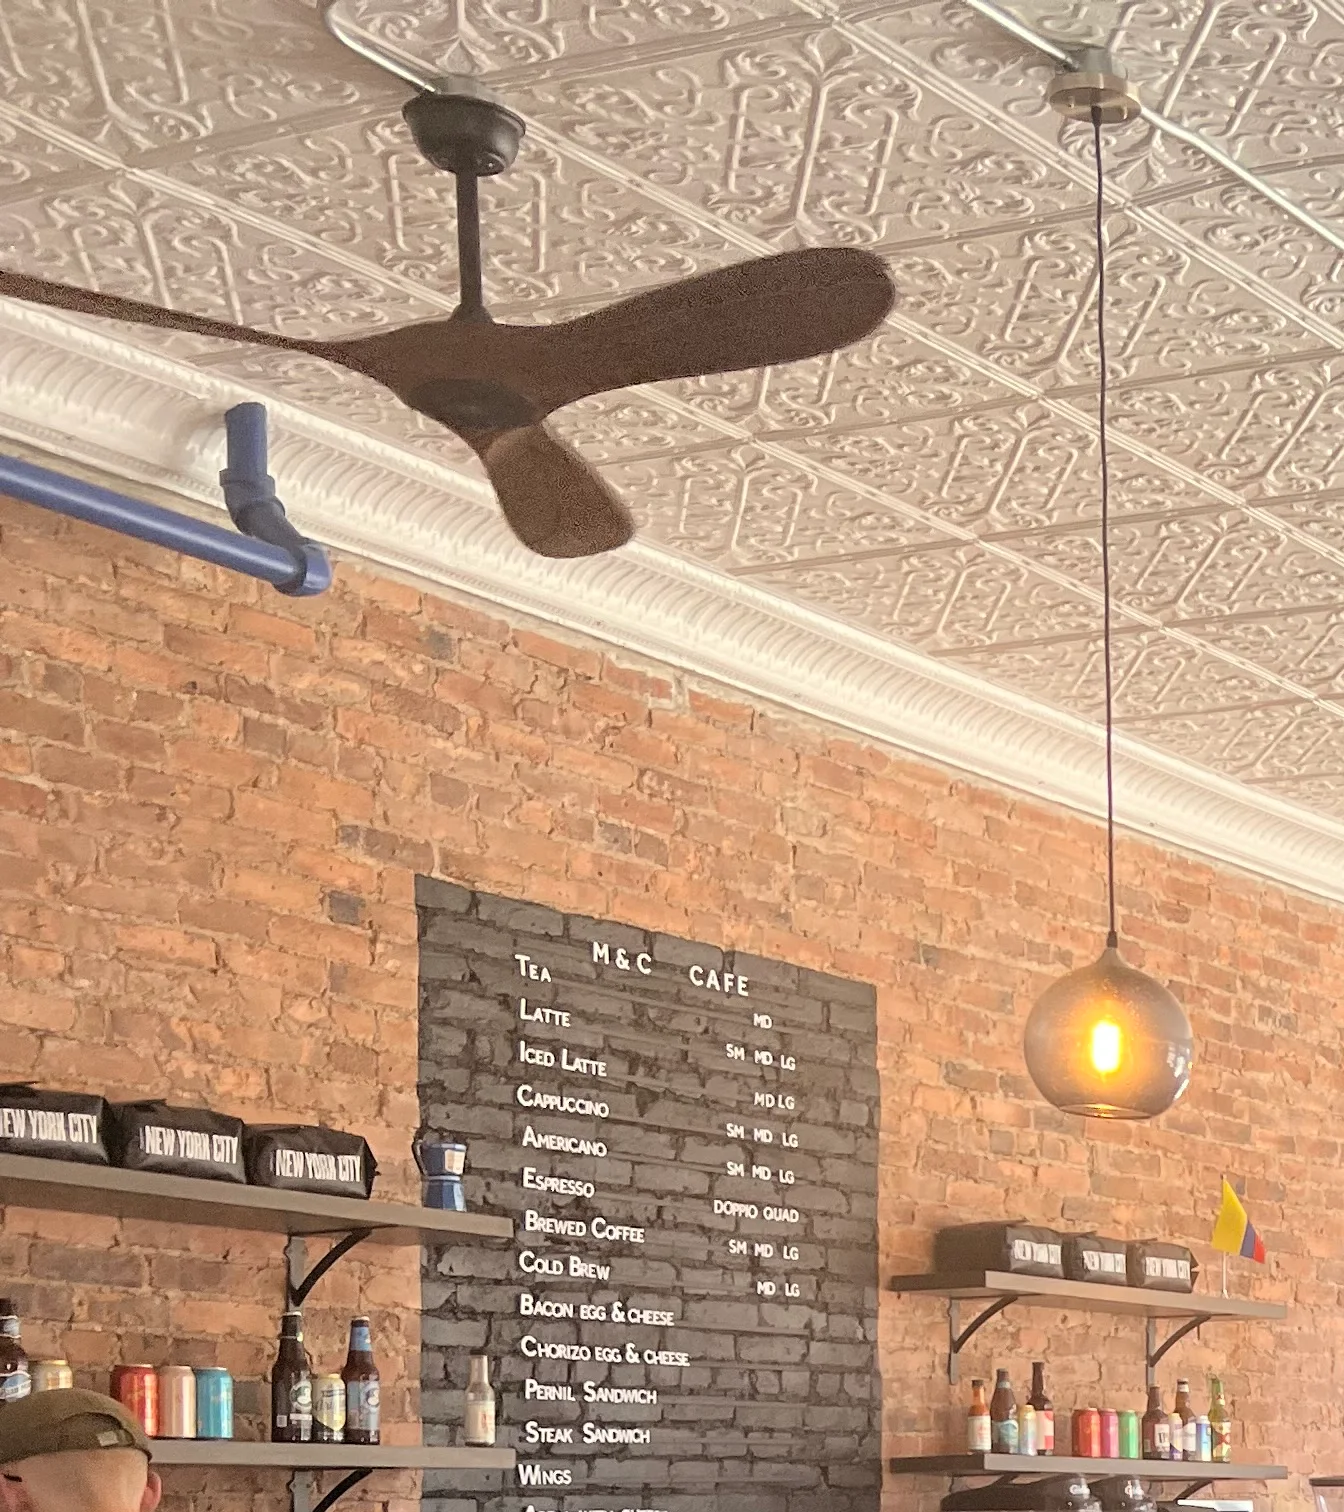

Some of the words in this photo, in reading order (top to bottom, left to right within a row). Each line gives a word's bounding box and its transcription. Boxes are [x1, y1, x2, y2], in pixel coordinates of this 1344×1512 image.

[514, 954, 552, 983] TEA
[689, 965, 749, 997] CAFE
[520, 998, 571, 1028] LATTE
[753, 1013, 773, 1029] MD
[520, 1040, 555, 1067] ICED
[562, 1048, 607, 1077] LATTE
[725, 1043, 745, 1061] SM
[754, 1050, 773, 1066] MD
[781, 1054, 796, 1071] LG
[517, 1084, 610, 1118] CAPPUCCINO
[754, 1092, 775, 1108] MD
[778, 1095, 795, 1110] LG
[68, 1113, 98, 1144] CITY
[522, 1125, 608, 1157] AMERICANO
[726, 1123, 745, 1140] SM
[753, 1128, 773, 1143] MD
[782, 1132, 799, 1148] LG
[145, 1125, 175, 1156] NEW
[212, 1134, 239, 1164] CITY
[275, 1149, 304, 1178] NEW
[338, 1155, 361, 1182] CITY
[726, 1161, 745, 1177] SM
[752, 1165, 771, 1180] MD
[779, 1169, 795, 1185] LG
[523, 1166, 595, 1198] ESPRESSO
[713, 1199, 758, 1219] DOPPIO
[763, 1206, 800, 1223] QUAD
[525, 1209, 587, 1237] BREWED
[591, 1216, 645, 1244] COFFEE
[728, 1238, 747, 1255] SM
[754, 1243, 774, 1258] MD
[783, 1245, 799, 1261] LG
[518, 1250, 564, 1275] COLD
[569, 1255, 611, 1280] BREW
[756, 1281, 776, 1296] MD
[785, 1282, 800, 1298] LG
[519, 1293, 575, 1319] BACON
[580, 1304, 607, 1321] EGG
[611, 1301, 626, 1323] &
[627, 1308, 675, 1327] CHEESE
[520, 1335, 591, 1361] CHORIZO
[595, 1346, 622, 1363] EGG
[625, 1342, 640, 1364] &
[643, 1349, 691, 1366] CHEESE
[524, 1378, 576, 1402] PERNIL
[583, 1380, 657, 1404] SANDWICH
[525, 1420, 573, 1444] STEAK
[582, 1422, 651, 1444] SANDWICH
[518, 1463, 572, 1486] WINGS
